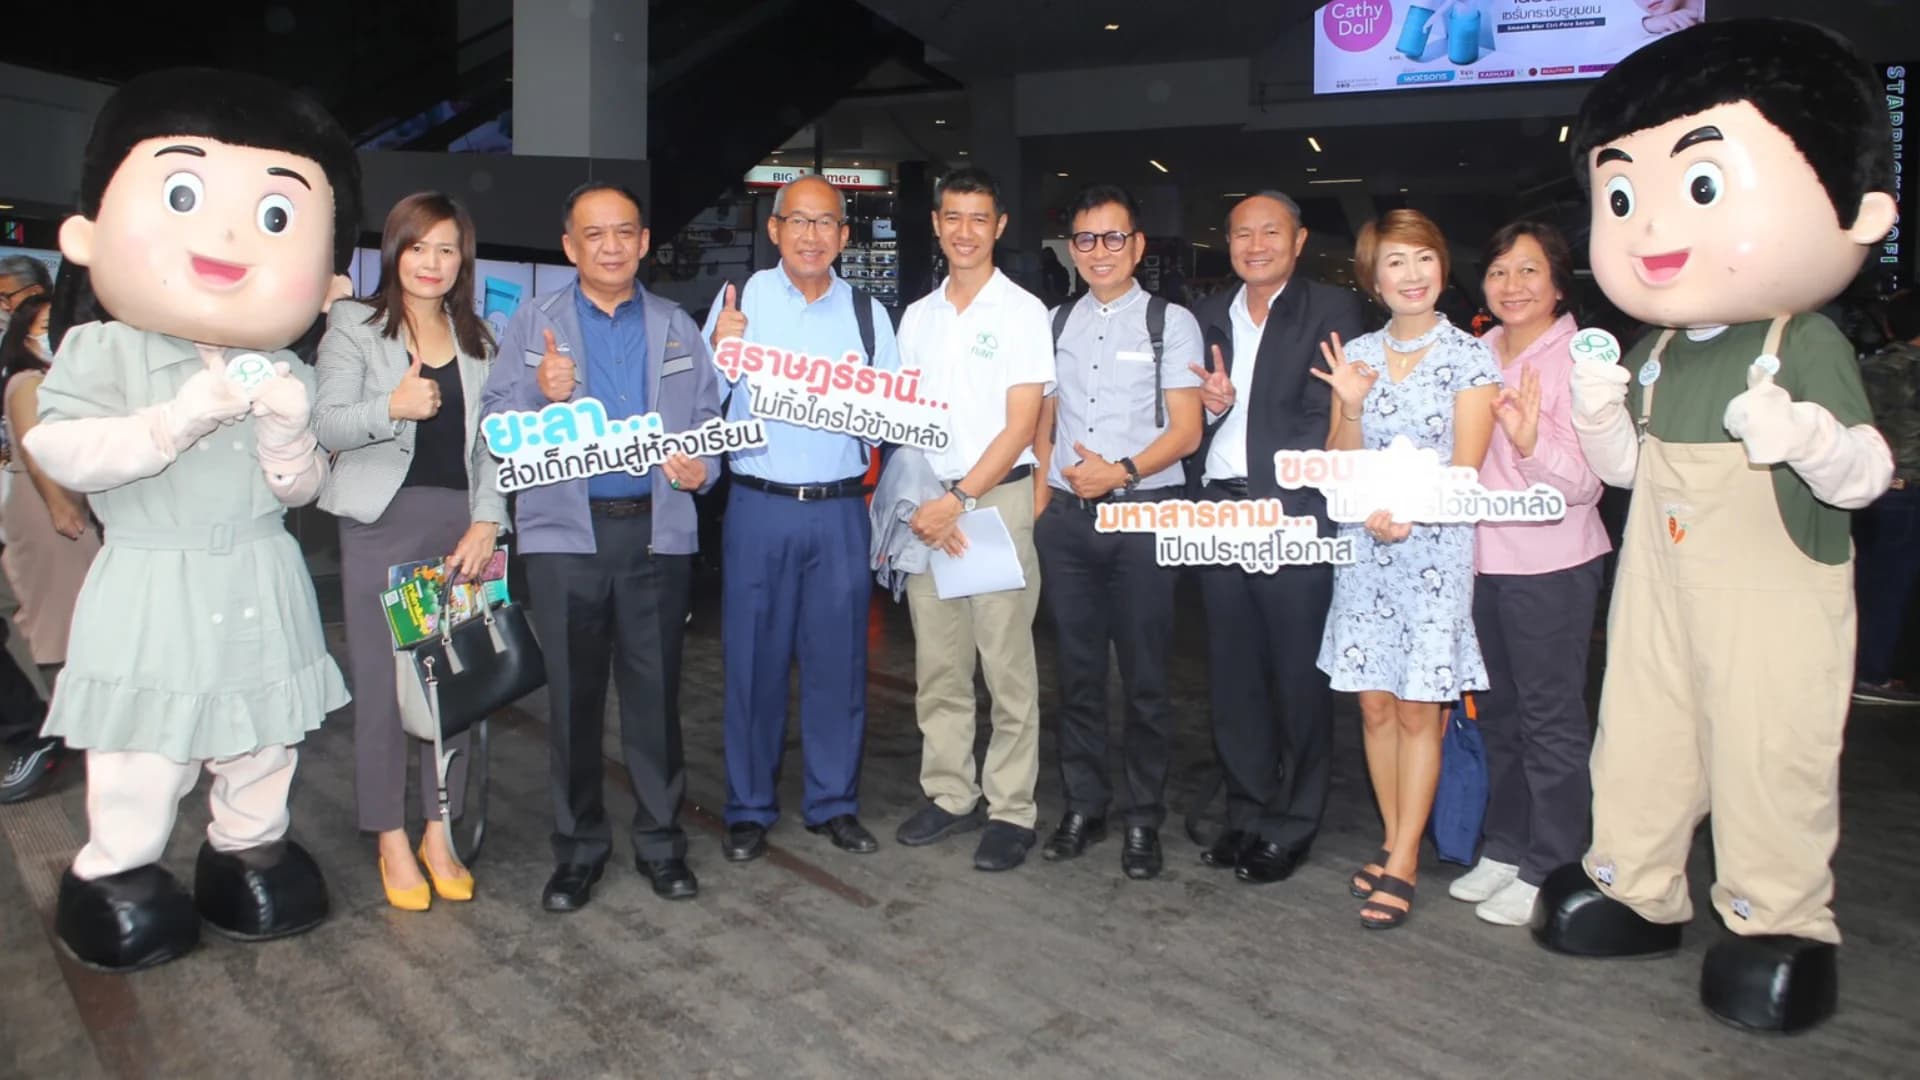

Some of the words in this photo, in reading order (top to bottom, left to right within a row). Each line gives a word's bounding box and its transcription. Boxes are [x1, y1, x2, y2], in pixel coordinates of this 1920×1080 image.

[1331, 1, 1383, 20] Cathy
[1338, 18, 1373, 36] Doll
[773, 172, 793, 182] BIG
[716, 341, 949, 410] สุราษฎร์ธานี...
[485, 402, 657, 453] ยะลา...
[751, 384, 949, 449] ไม่ทิ้งใครไว้ข้างหลัง
[499, 422, 763, 488] ส่งเด็กคืนสู่ห้องเรียน
[1099, 502, 1312, 528] มหาสารคาม...
[1160, 529, 1353, 570] เปิดประตูสู่โอกาส
